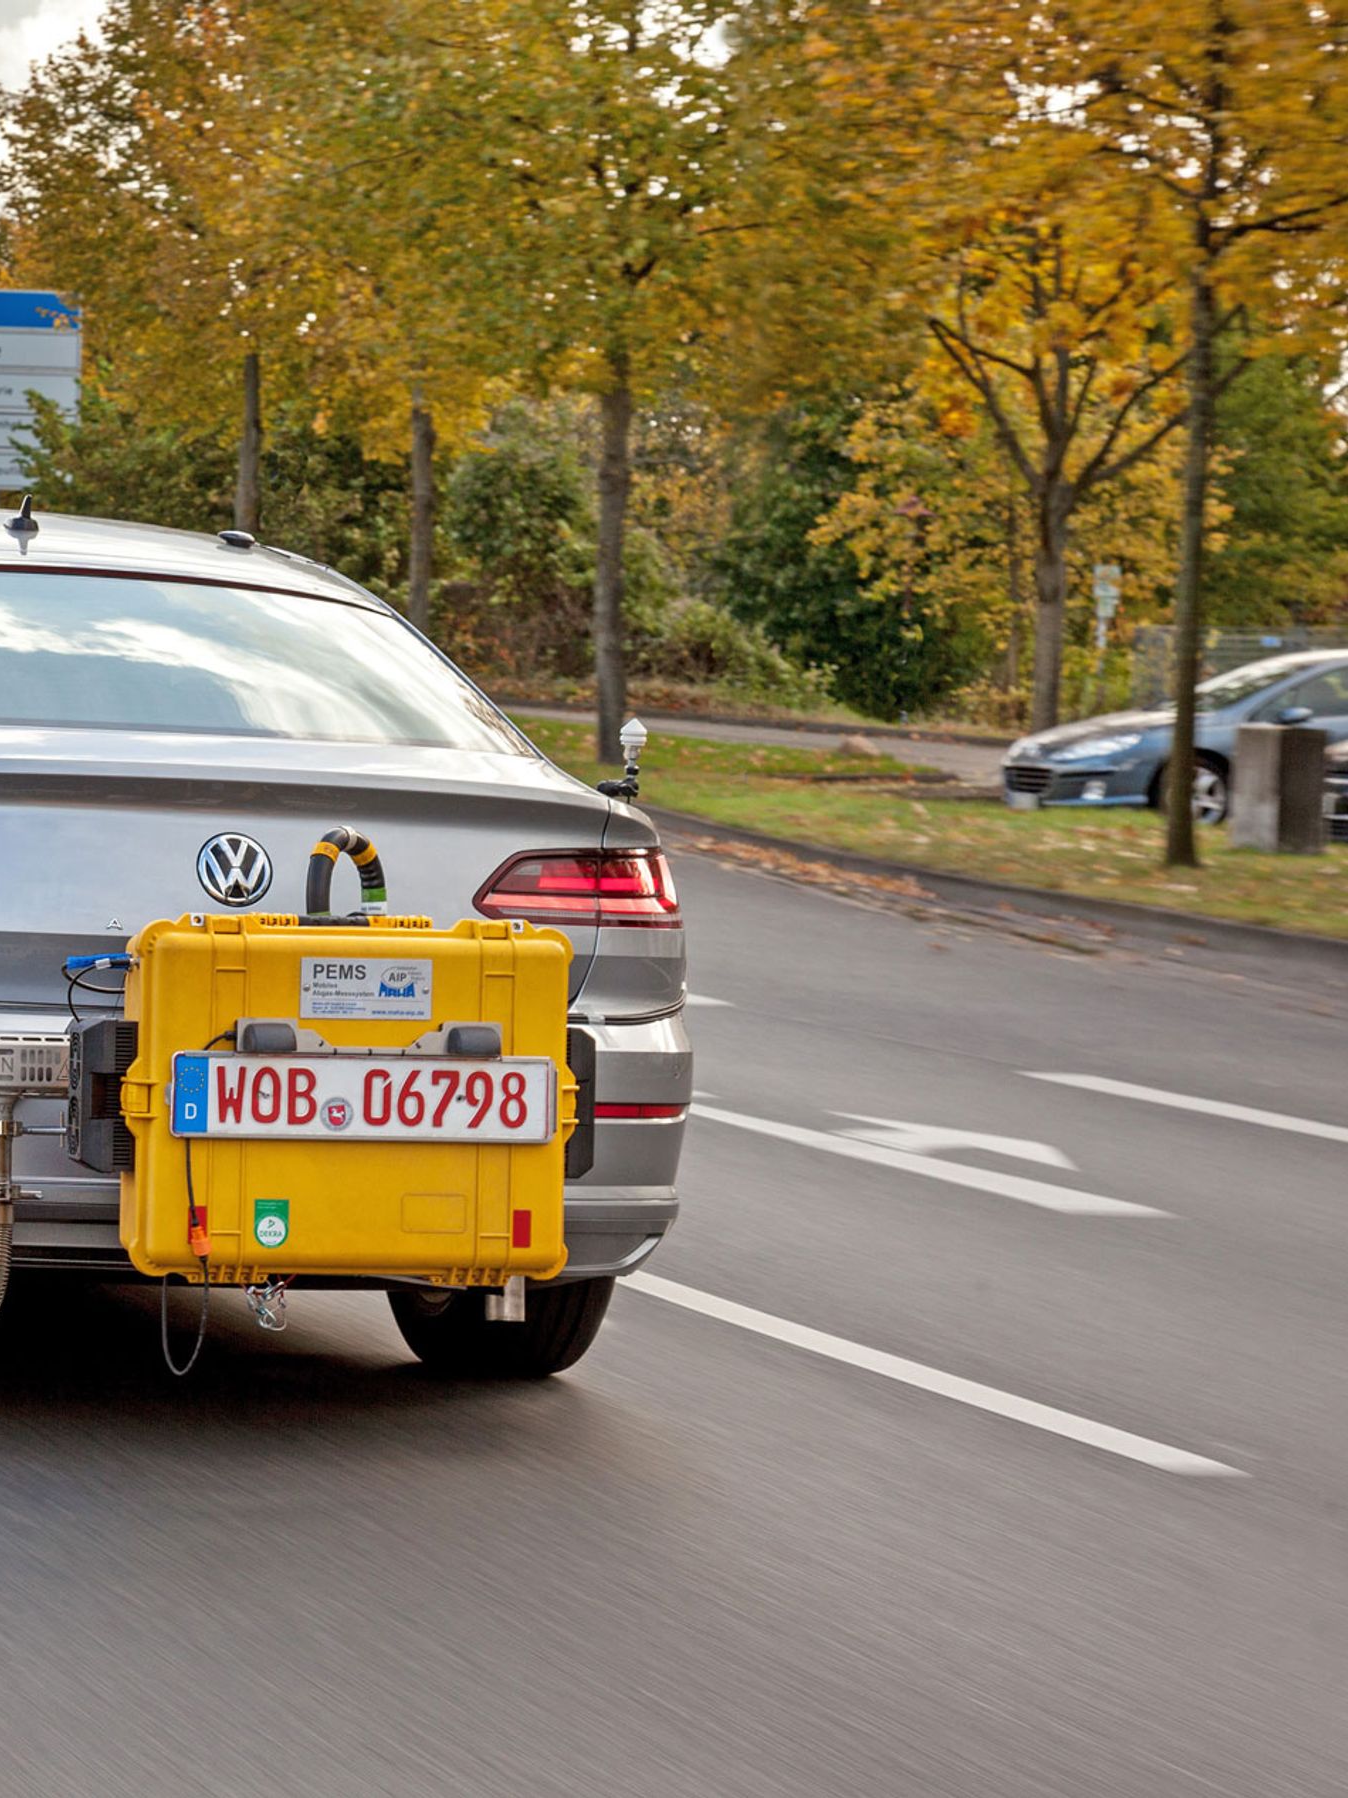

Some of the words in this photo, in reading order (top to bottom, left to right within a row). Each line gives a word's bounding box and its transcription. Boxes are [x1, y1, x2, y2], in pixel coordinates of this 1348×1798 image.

[313, 964, 367, 980] PEMS
[184, 1103, 197, 1120] D
[216, 1065, 317, 1126] WOB
[363, 1068, 528, 1129] 06798
